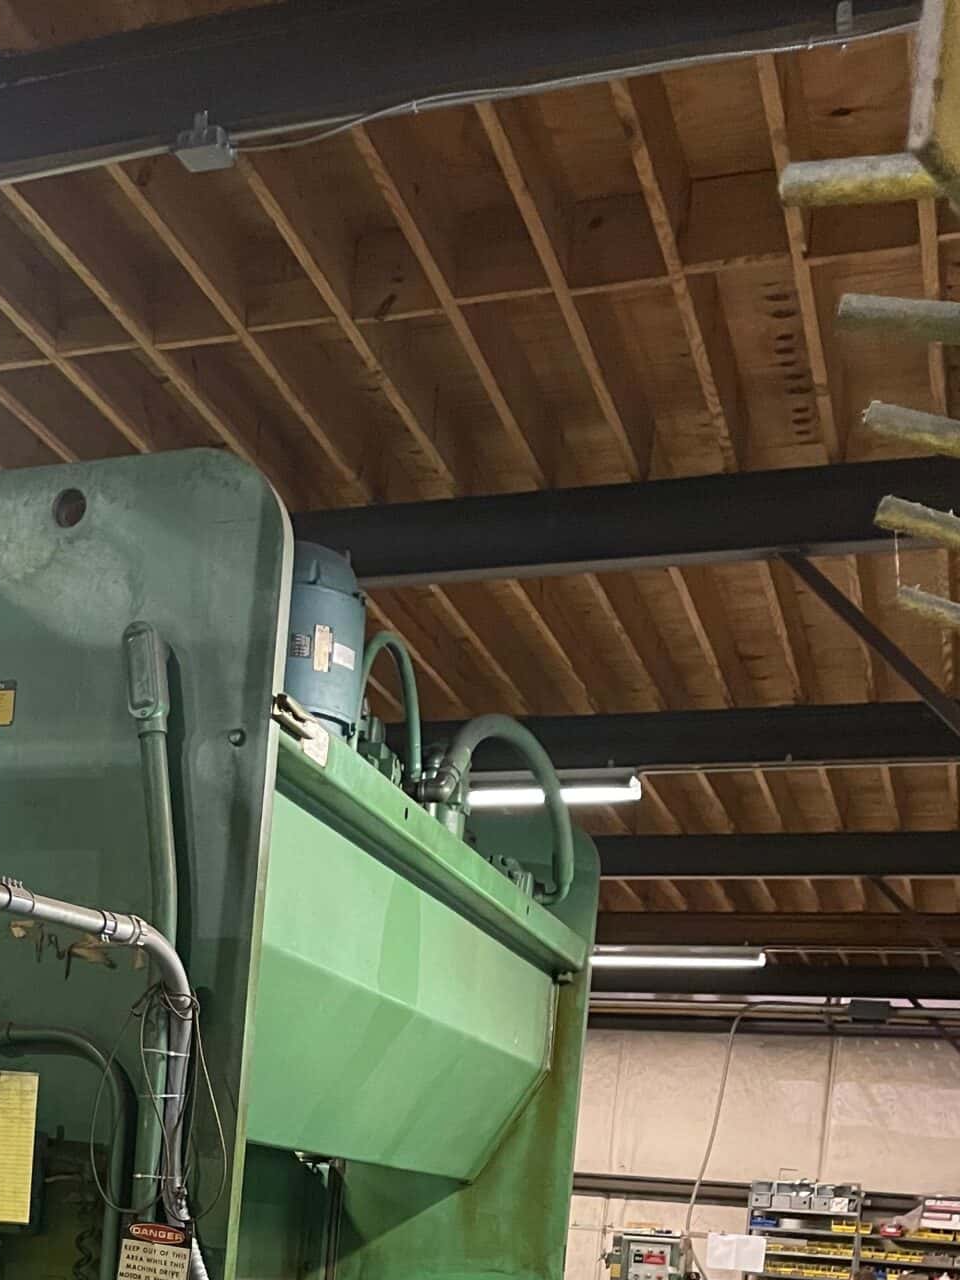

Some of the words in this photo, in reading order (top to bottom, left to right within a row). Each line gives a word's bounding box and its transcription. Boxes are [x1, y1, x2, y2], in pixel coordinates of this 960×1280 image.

[132, 1226, 183, 1241] DANGER
[124, 1244, 140, 1252] KEEP
[143, 1247, 156, 1255] OUT
[172, 1251, 187, 1260] THIS
[126, 1253, 143, 1262] AREA
[147, 1258, 167, 1266] WHILE
[170, 1261, 185, 1269] THIS
[119, 1271, 141, 1280] MOTOR
[126, 1263, 157, 1274] MACHINE
[159, 1269, 179, 1278] DRIVE
